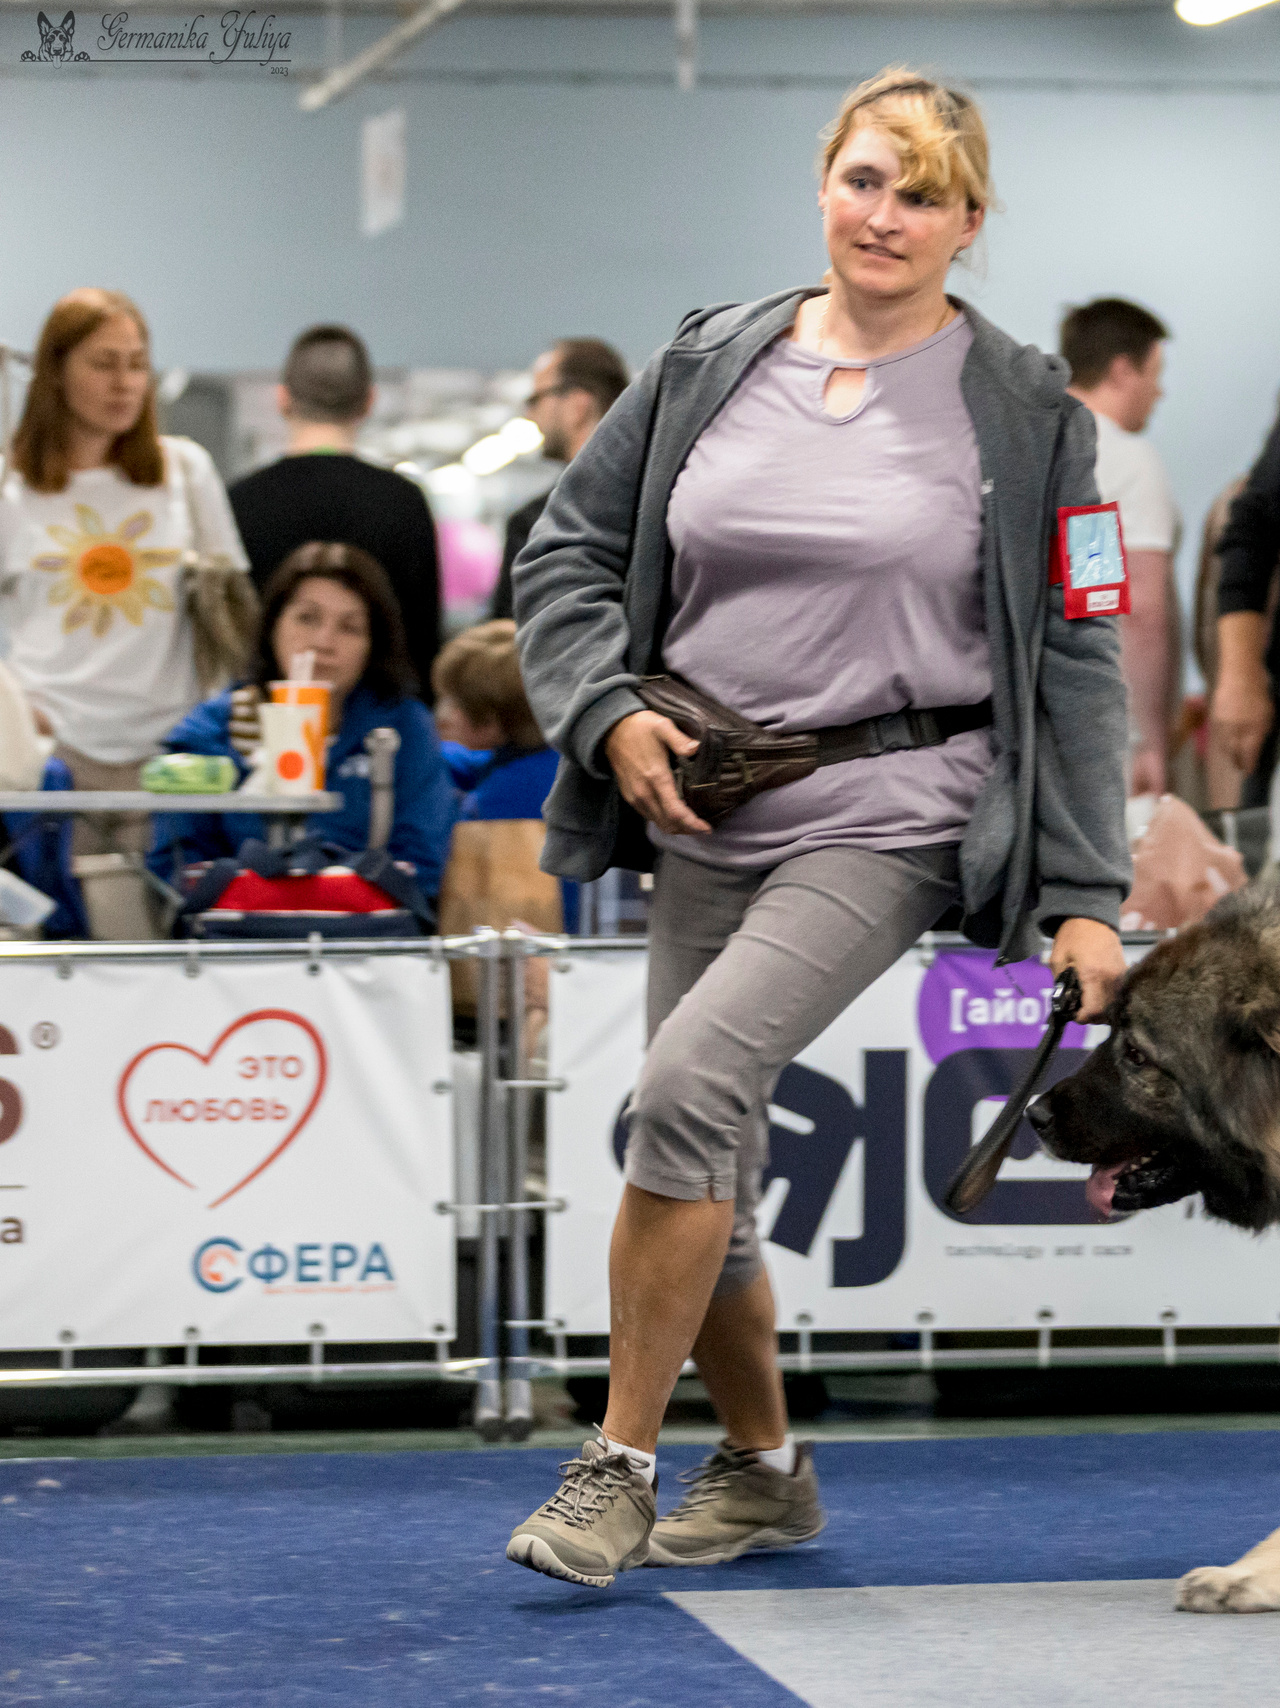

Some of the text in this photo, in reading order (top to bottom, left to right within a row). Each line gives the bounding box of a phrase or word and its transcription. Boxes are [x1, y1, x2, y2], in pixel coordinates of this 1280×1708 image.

[239, 1056, 302, 1079] ЭТО
[144, 1098, 289, 1123] ЛЮБОВЬ
[192, 1236, 395, 1293] СФЕРА
